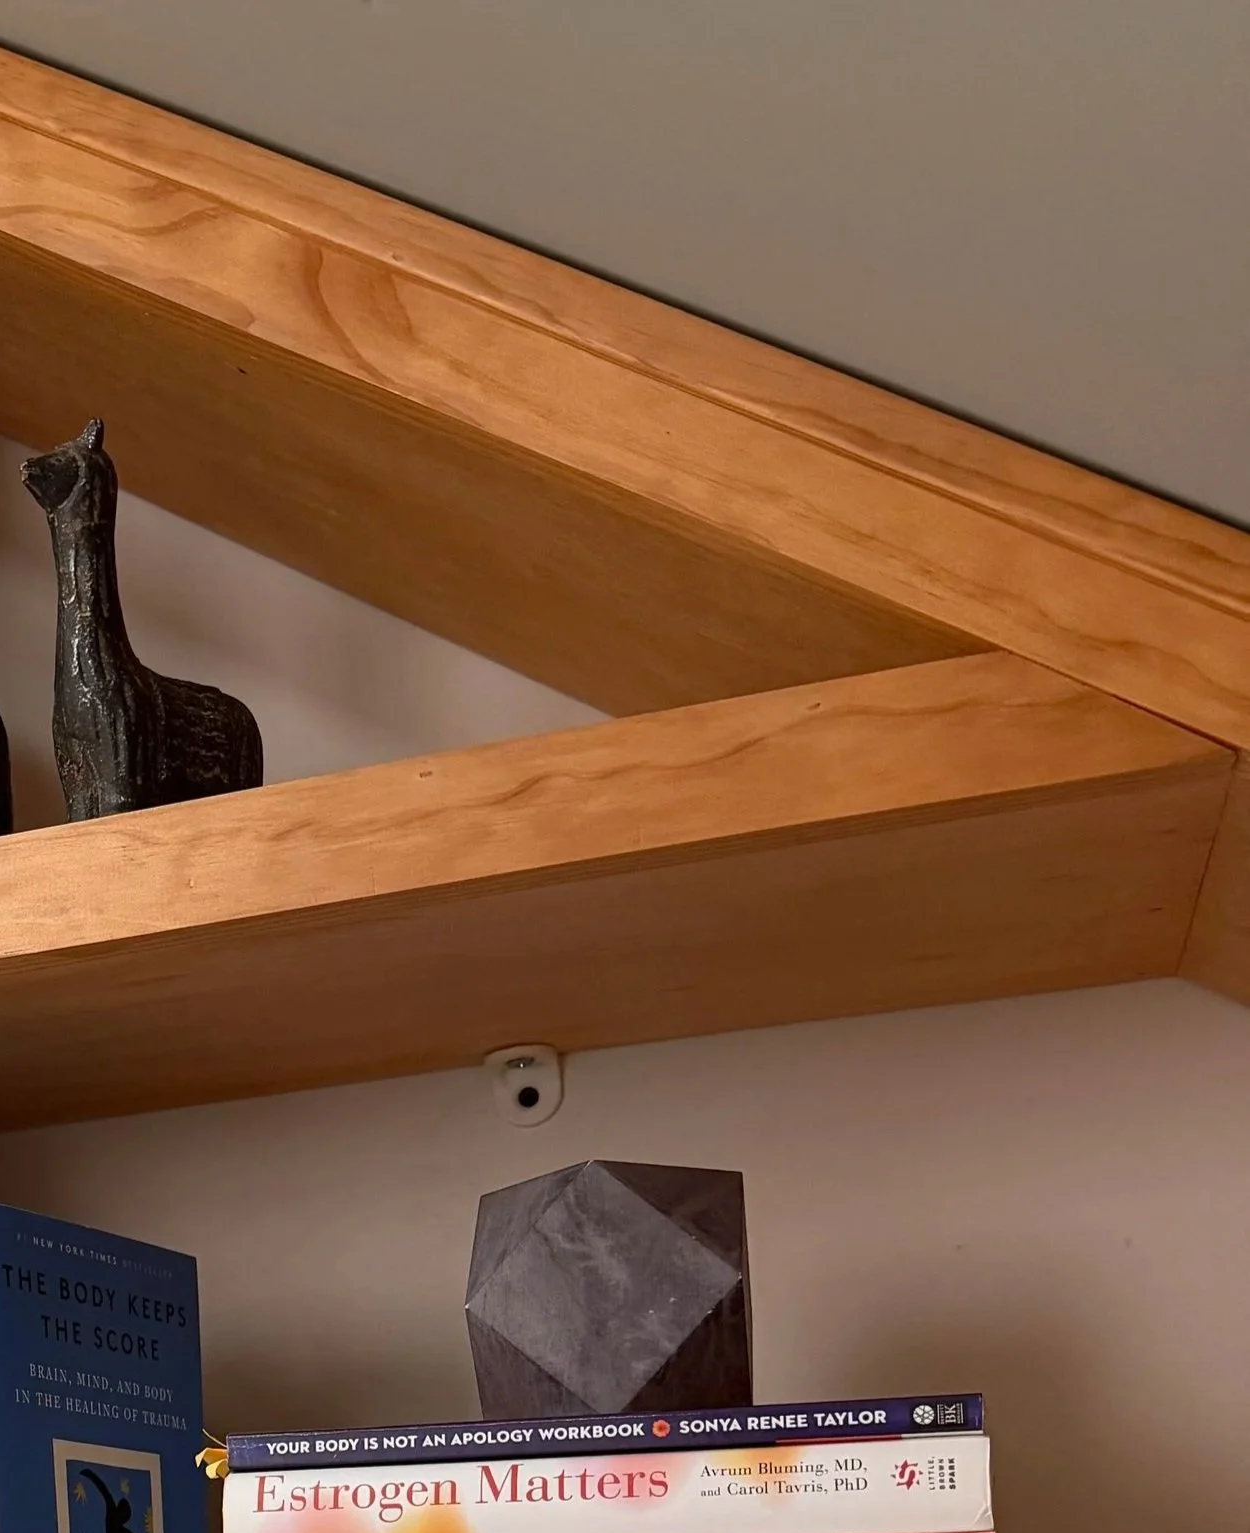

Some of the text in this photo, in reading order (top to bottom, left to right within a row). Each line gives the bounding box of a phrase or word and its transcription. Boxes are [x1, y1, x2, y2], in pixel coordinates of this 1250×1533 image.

[679, 1410, 886, 1434] SONYA RENEE TAYLOR
[267, 1422, 645, 1455] YOUR BODY IS NOT AN APOLOGY WORKBOOK
[700, 1457, 868, 1479] Avrum Bluming, MD,
[252, 1463, 669, 1524] Estrogen Matters
[700, 1477, 868, 1497] and Carol Tavris, PhD
